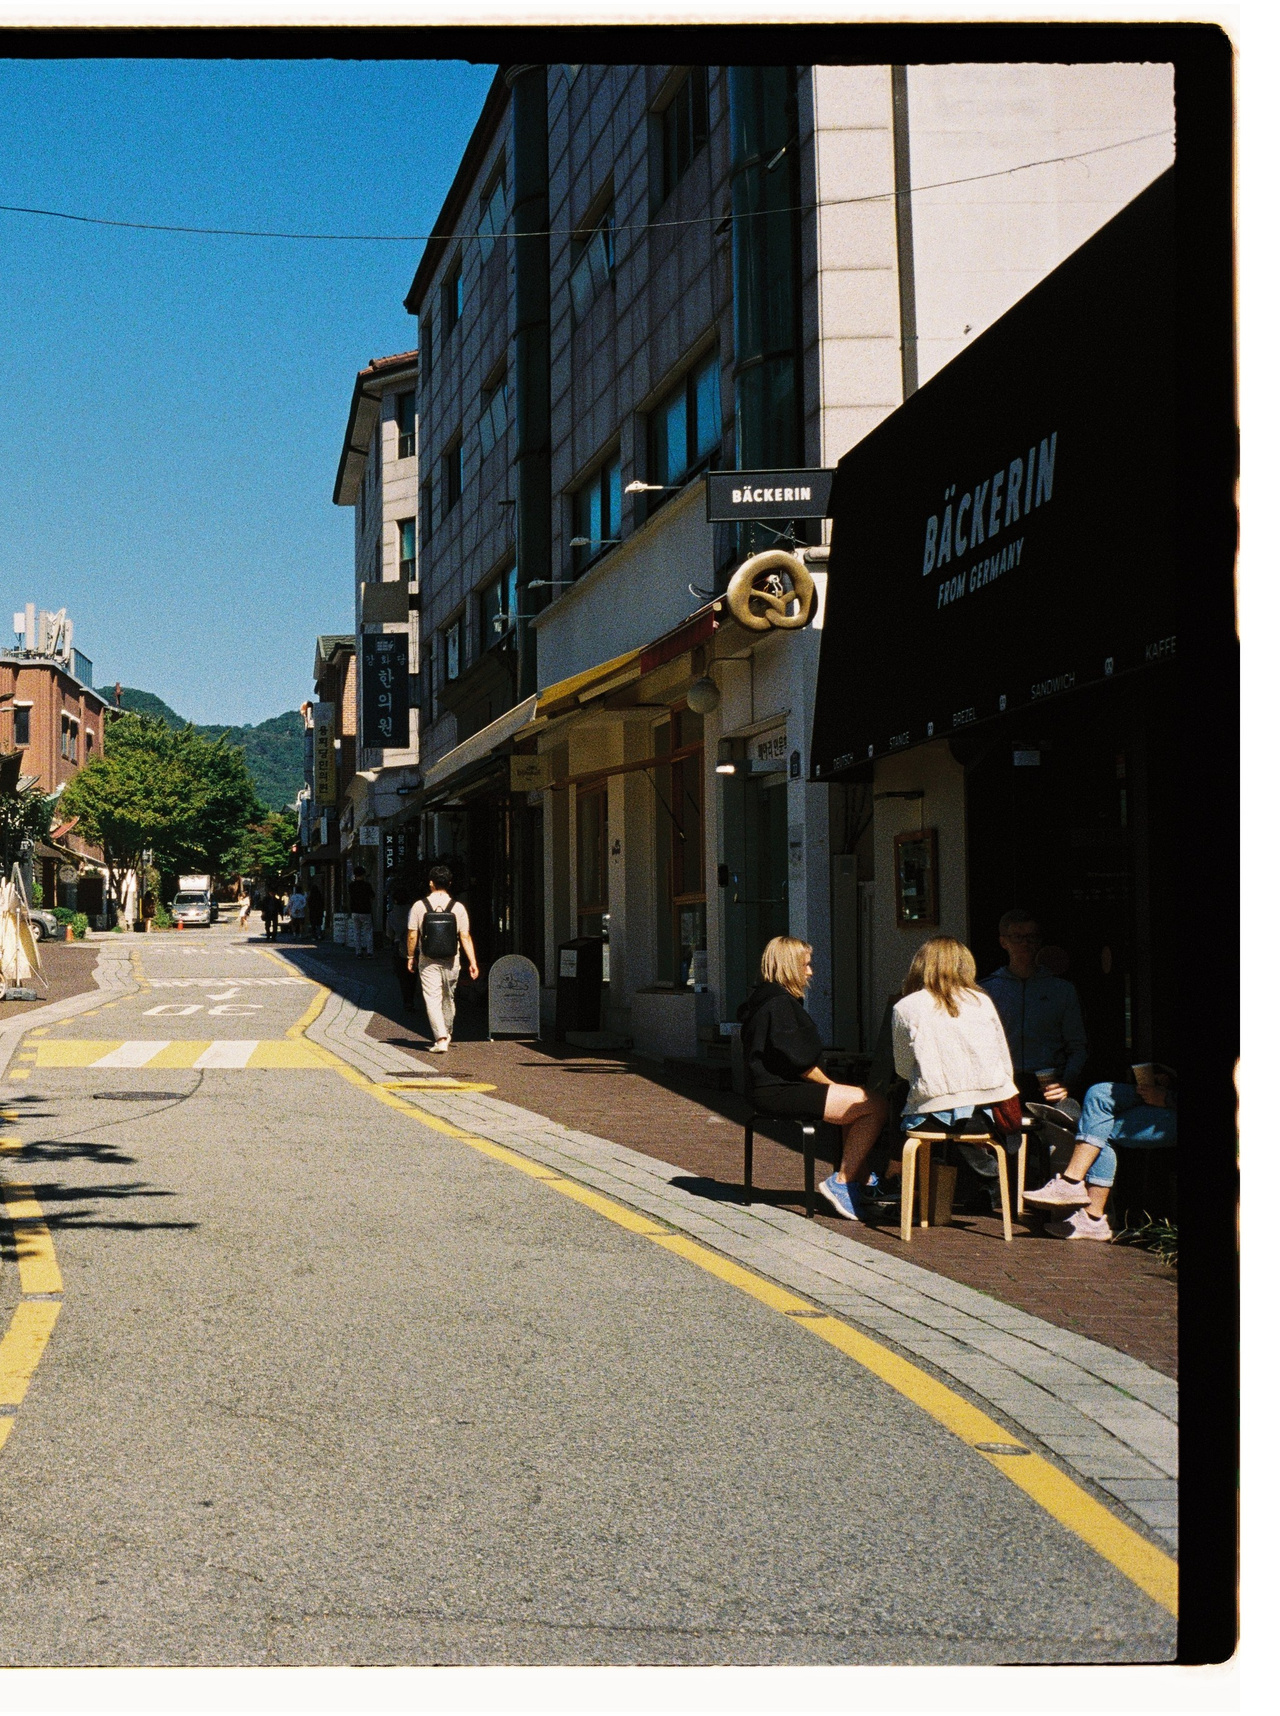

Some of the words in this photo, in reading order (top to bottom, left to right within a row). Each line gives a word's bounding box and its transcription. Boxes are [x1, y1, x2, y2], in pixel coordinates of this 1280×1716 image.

[732, 485, 811, 504] BÄCKERIN
[923, 431, 1058, 576] BÄCKERIN
[938, 572, 966, 610] FROM
[969, 537, 1025, 594] GERMANY
[377, 667, 396, 738] 한의원
[889, 730, 910, 751] STANGE
[952, 706, 978, 728] BREZEL
[1030, 671, 1076, 701] SANDWICH
